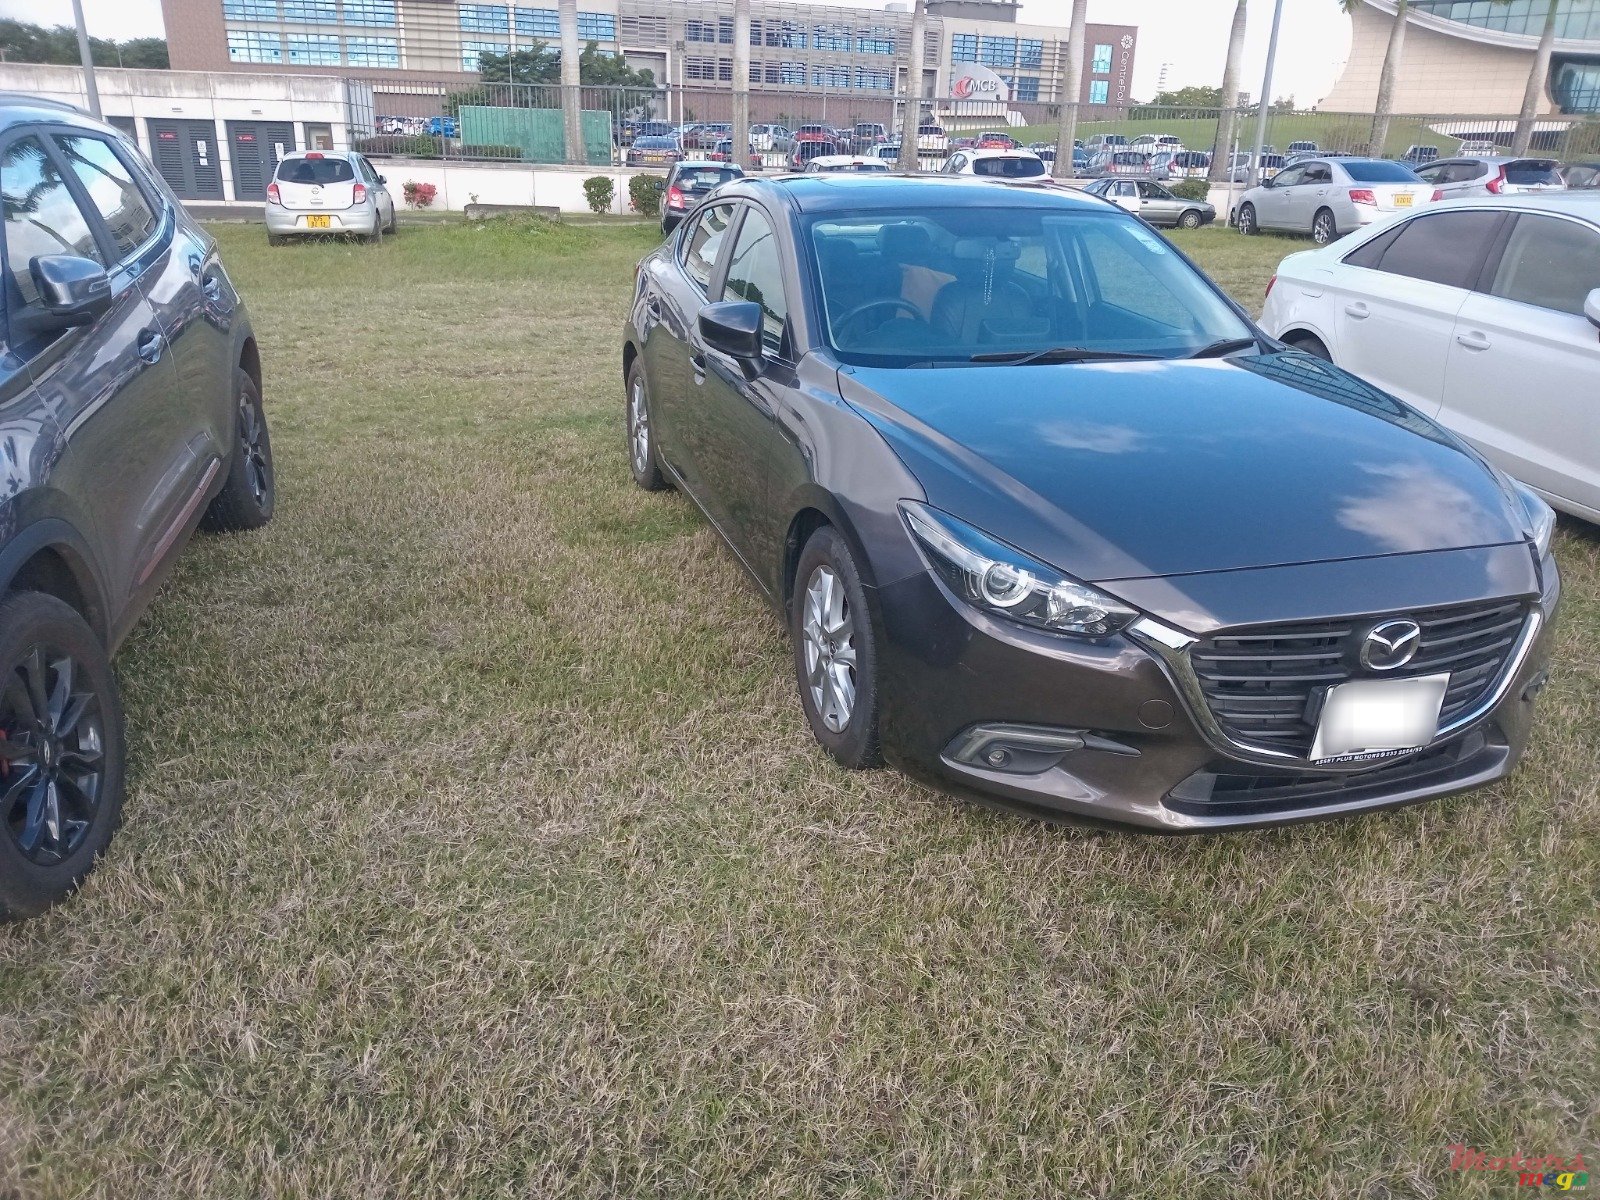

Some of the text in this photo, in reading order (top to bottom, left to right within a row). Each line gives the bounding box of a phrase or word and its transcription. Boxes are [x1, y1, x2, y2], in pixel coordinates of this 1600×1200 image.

[970, 79, 996, 92] MCB
[1336, 754, 1353, 763] PLUS
[1353, 752, 1380, 761] MOTORS
